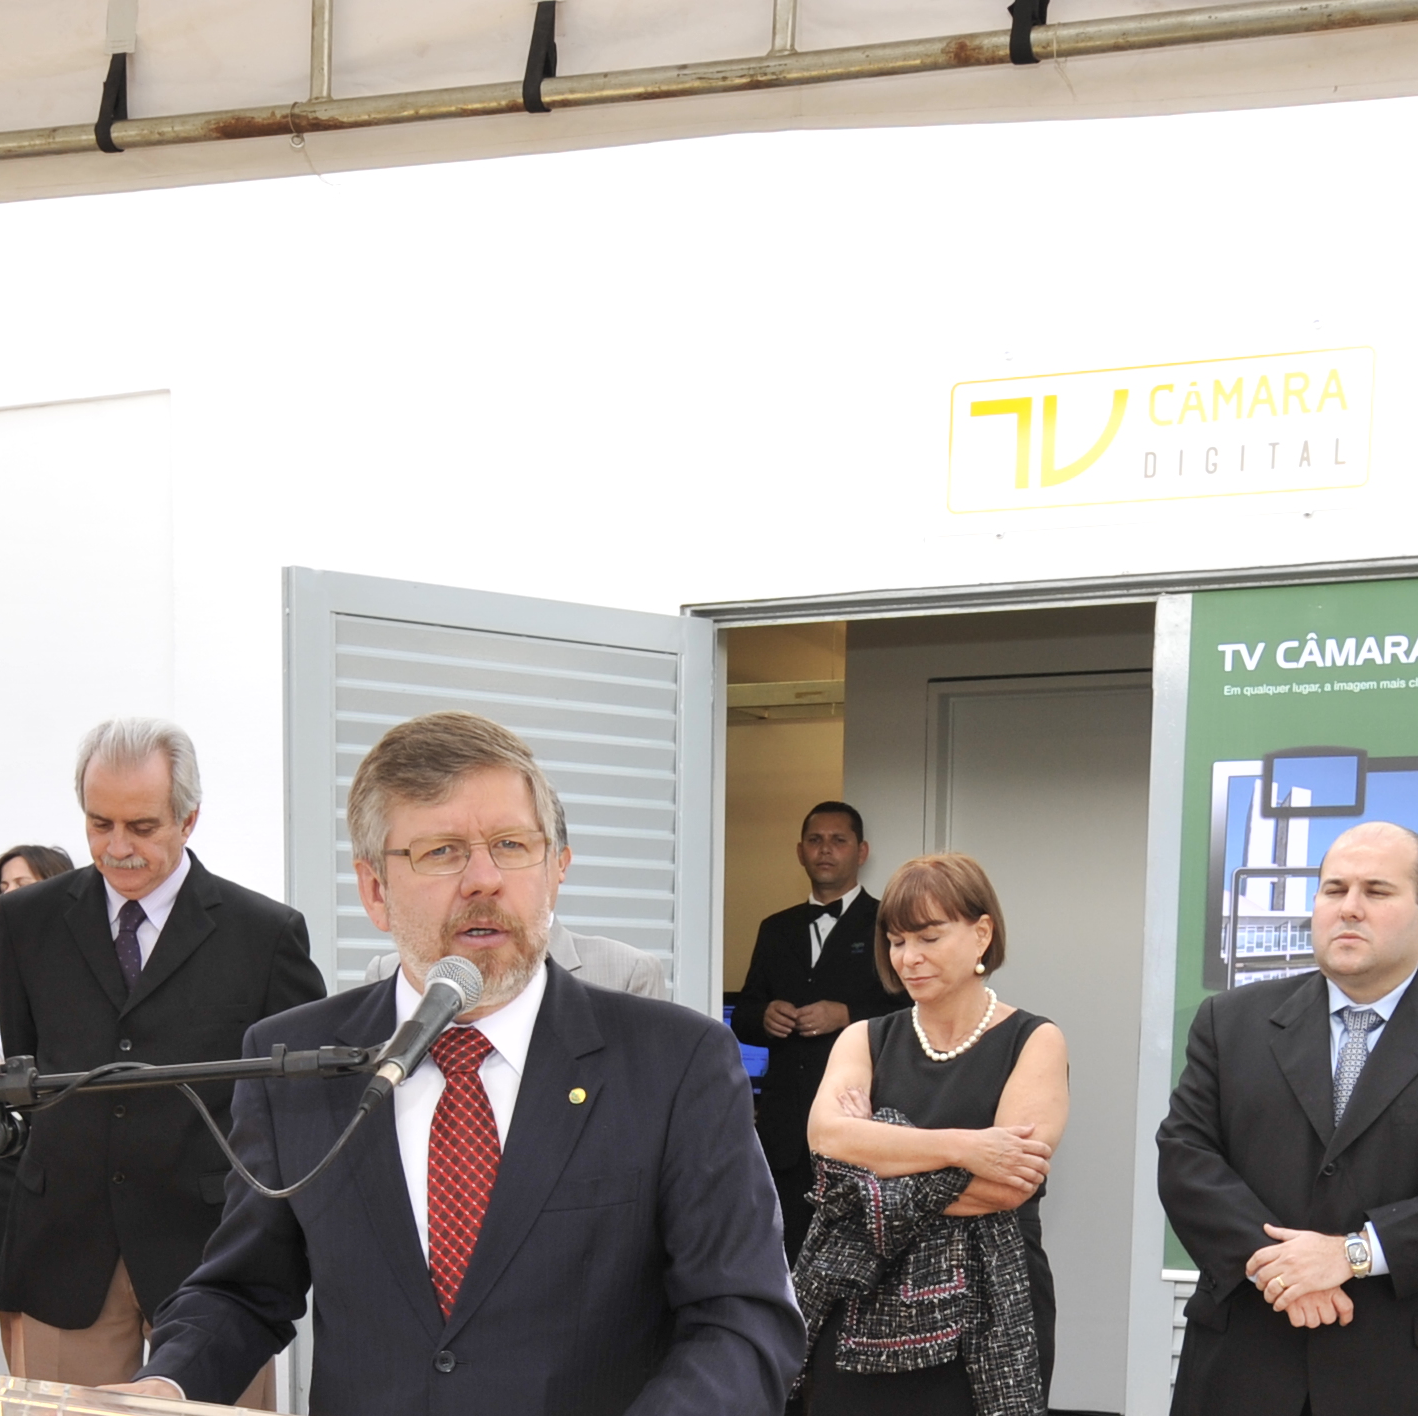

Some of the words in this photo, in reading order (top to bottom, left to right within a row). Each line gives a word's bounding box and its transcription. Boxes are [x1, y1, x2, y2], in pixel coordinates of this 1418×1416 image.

[1148, 368, 1349, 427] CÂMARA
[970, 388, 1129, 490] TV
[1143, 437, 1347, 479] DIGITAL
[1217, 642, 1266, 672] TV
[1223, 685, 1241, 696] Em
[1242, 683, 1291, 697] qualquer
[1292, 682, 1322, 695] lugar,
[1323, 683, 1332, 692] a
[1333, 679, 1378, 693] imagem
[1379, 677, 1407, 690] mais
